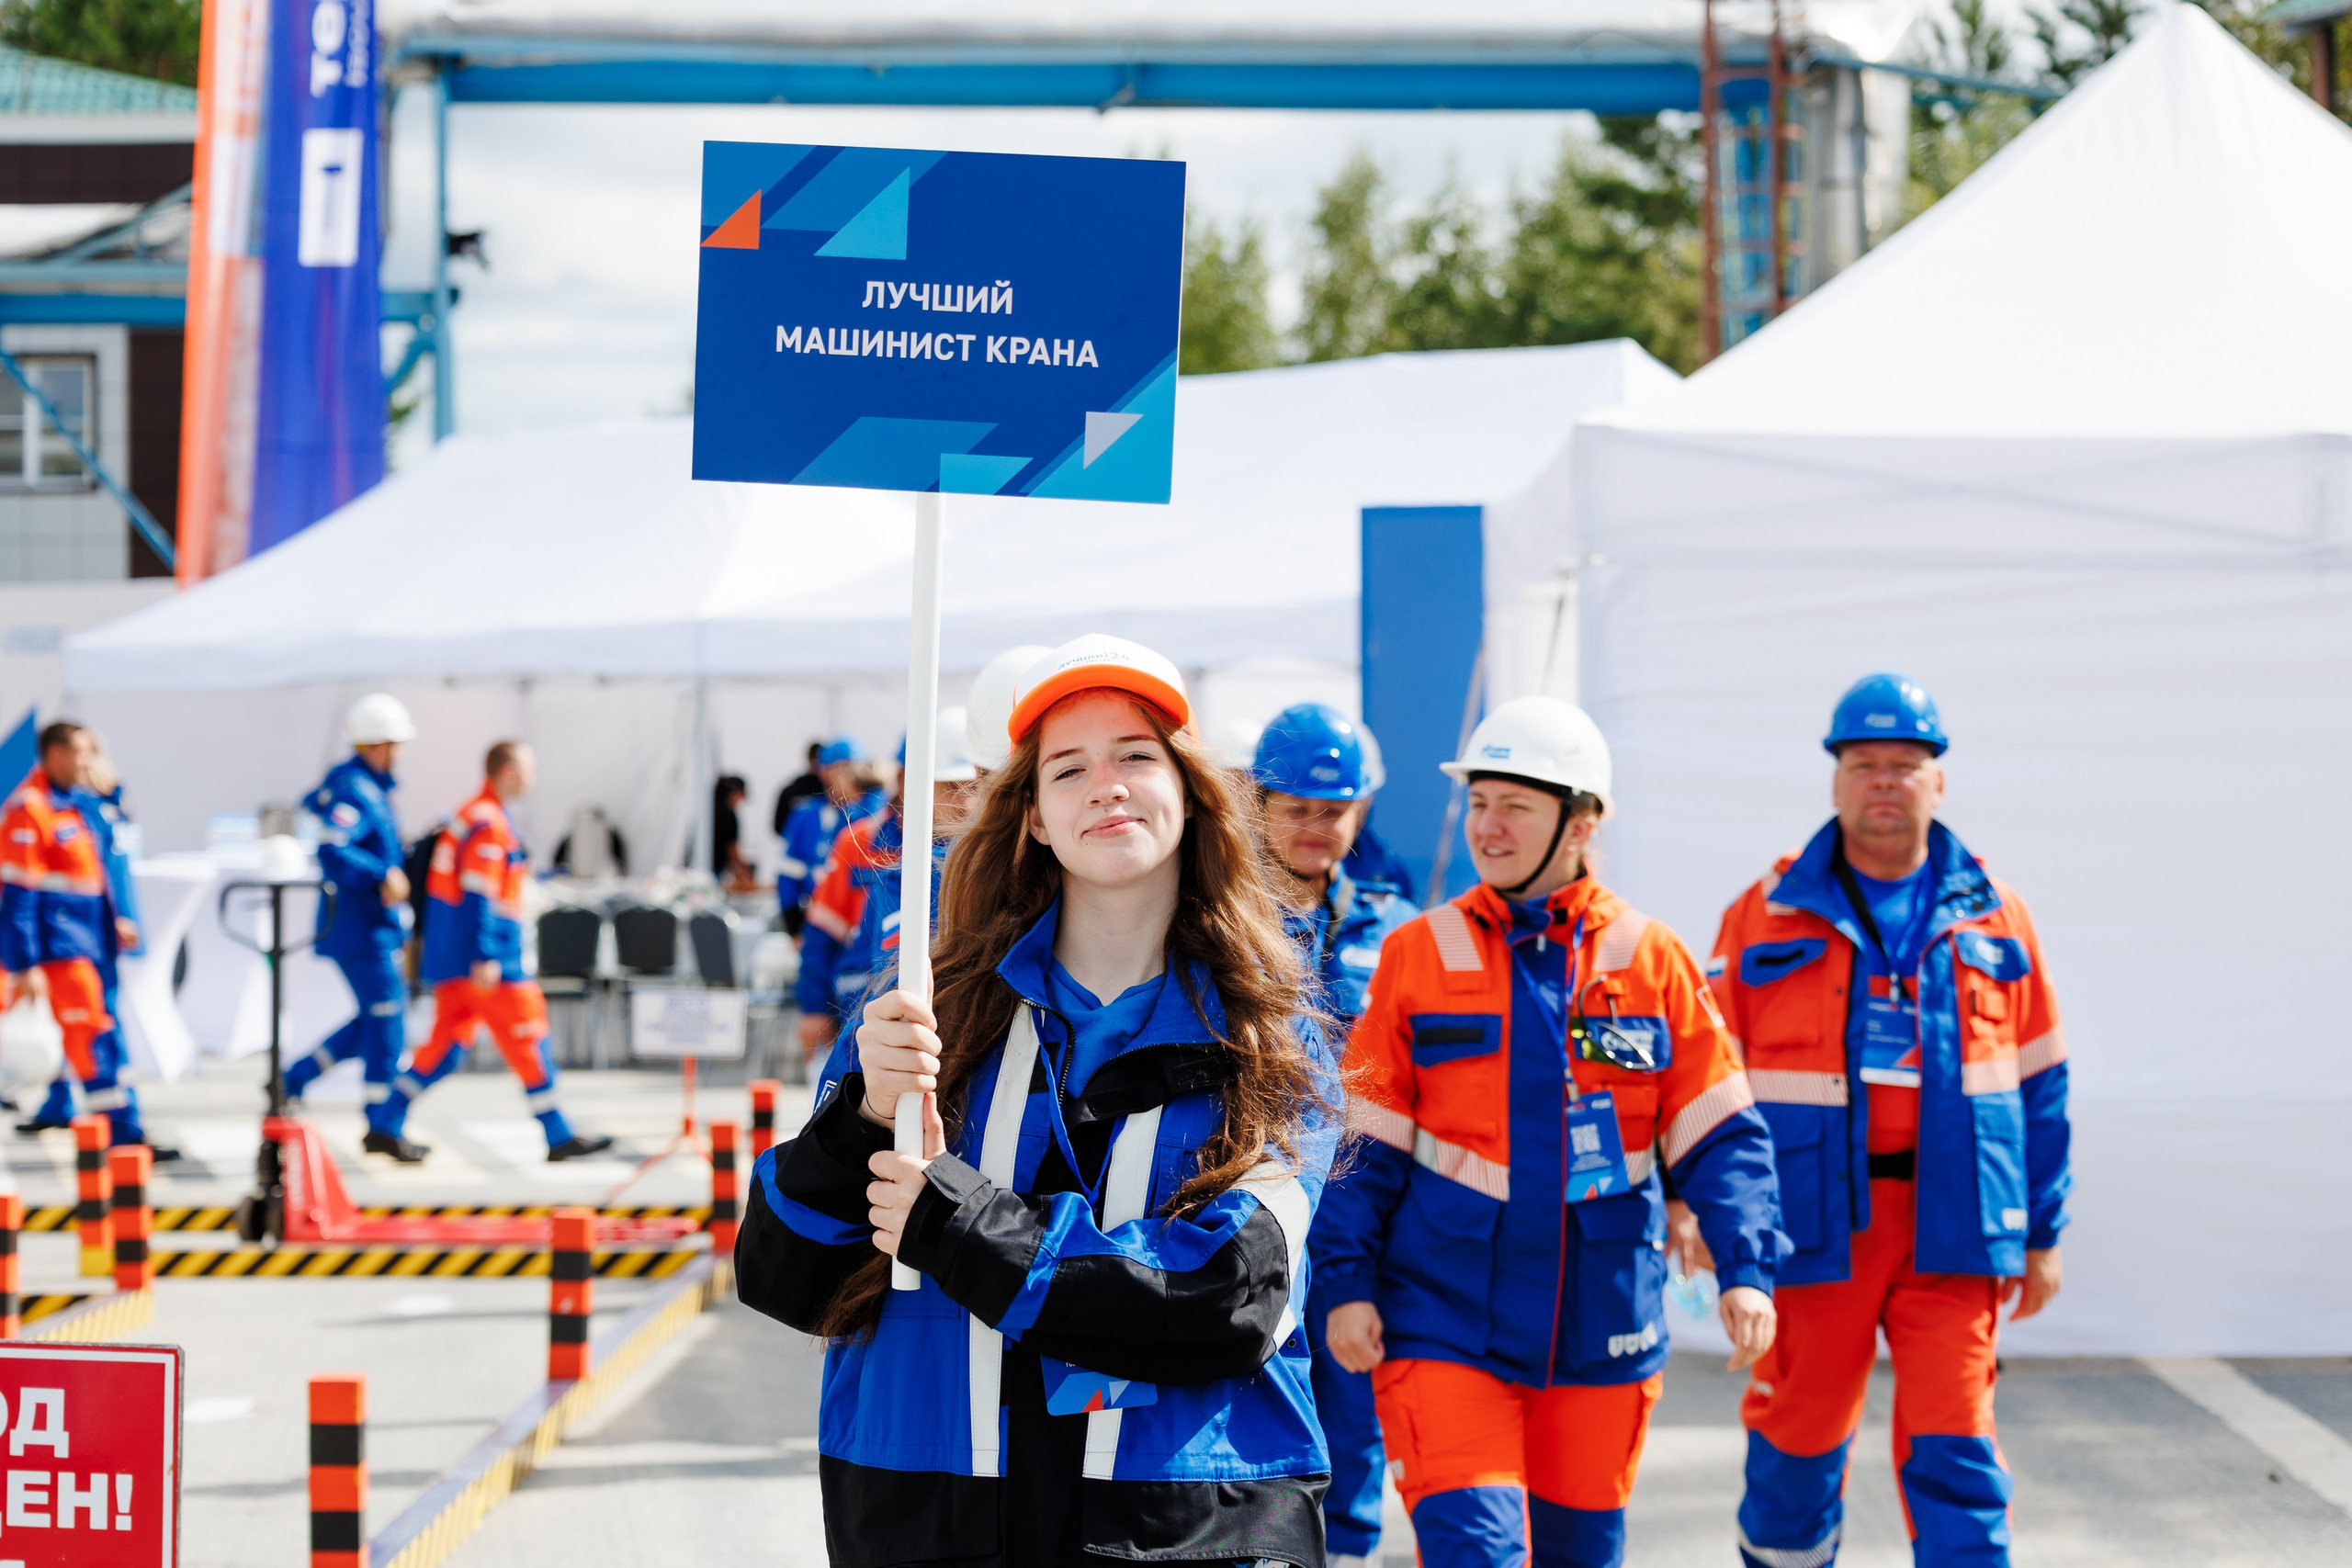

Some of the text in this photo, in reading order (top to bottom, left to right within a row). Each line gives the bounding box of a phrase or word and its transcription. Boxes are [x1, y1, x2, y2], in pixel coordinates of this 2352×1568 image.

[862, 279, 1013, 315] ЛУЧШИЙ
[775, 325, 1099, 368] МАШИНИСТ КРАНА
[0, 1387, 70, 1459] Д
[0, 1470, 133, 1538] ЕН!
